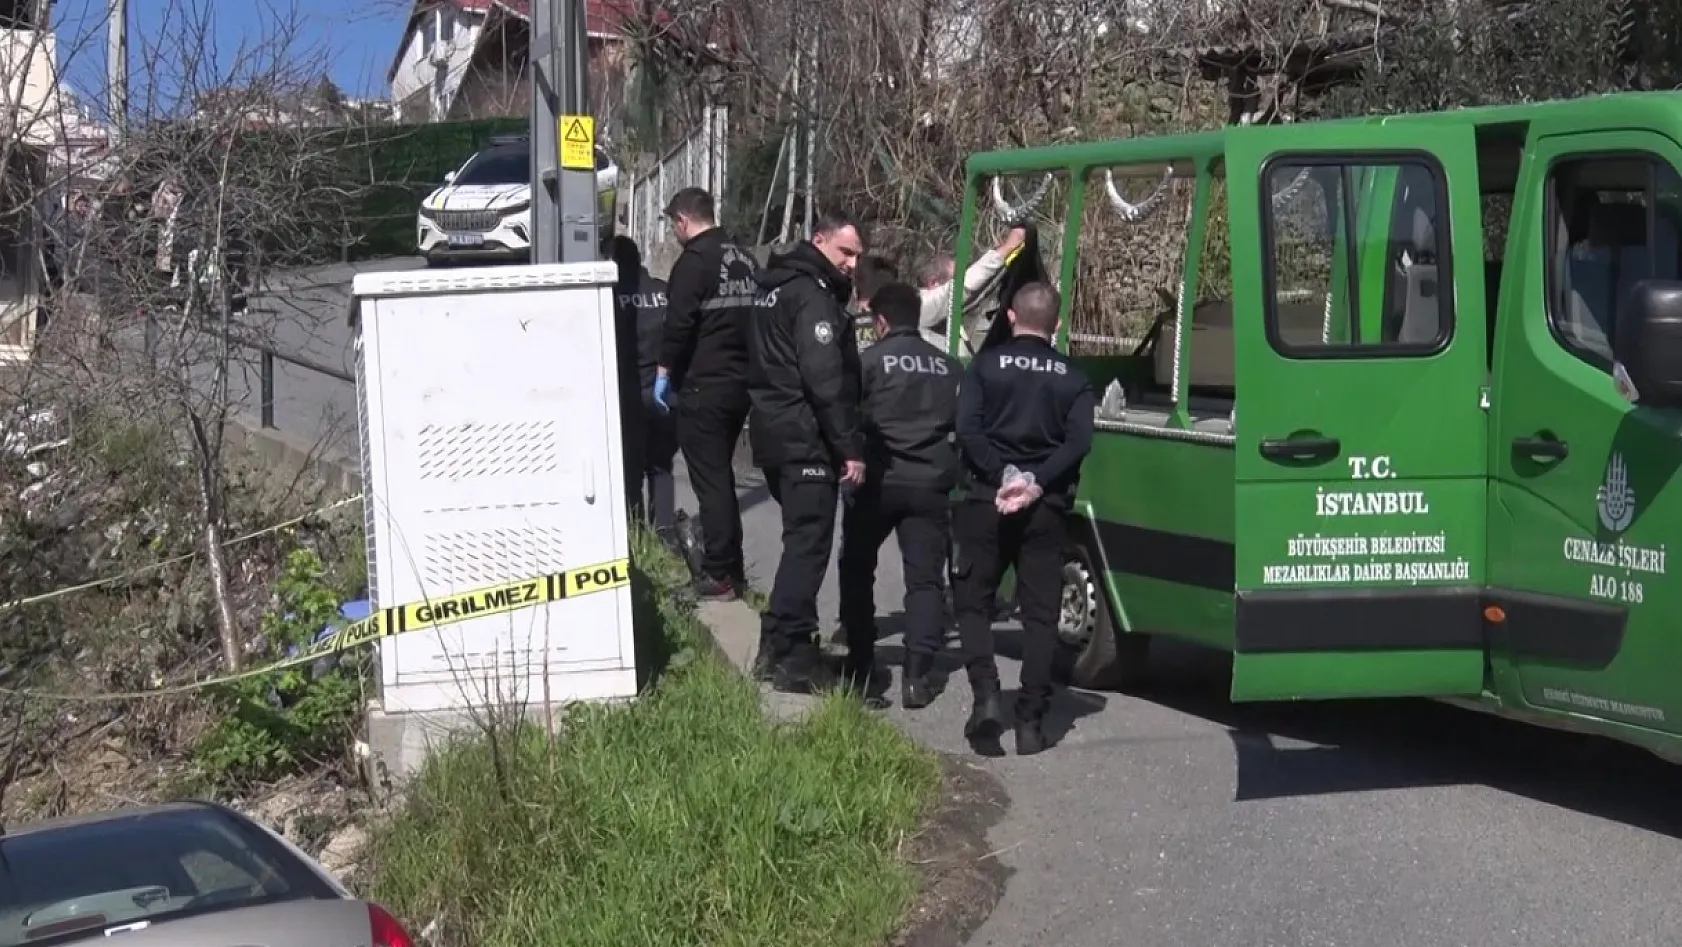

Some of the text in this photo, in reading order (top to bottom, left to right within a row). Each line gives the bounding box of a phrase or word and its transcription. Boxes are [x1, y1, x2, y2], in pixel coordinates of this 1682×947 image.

[1348, 456, 1397, 479] T.C.
[1316, 486, 1429, 516] İSTANBUL
[1287, 530, 1446, 560] BÜYÜKŞEHİR BELEDİYESİ
[1564, 537, 1666, 576] CENAZE İŞLERİ
[1263, 557, 1470, 585] MEZARLIKLAR DAİRE BAŞKANLIĞI
[1590, 574, 1644, 604] ALO 188
